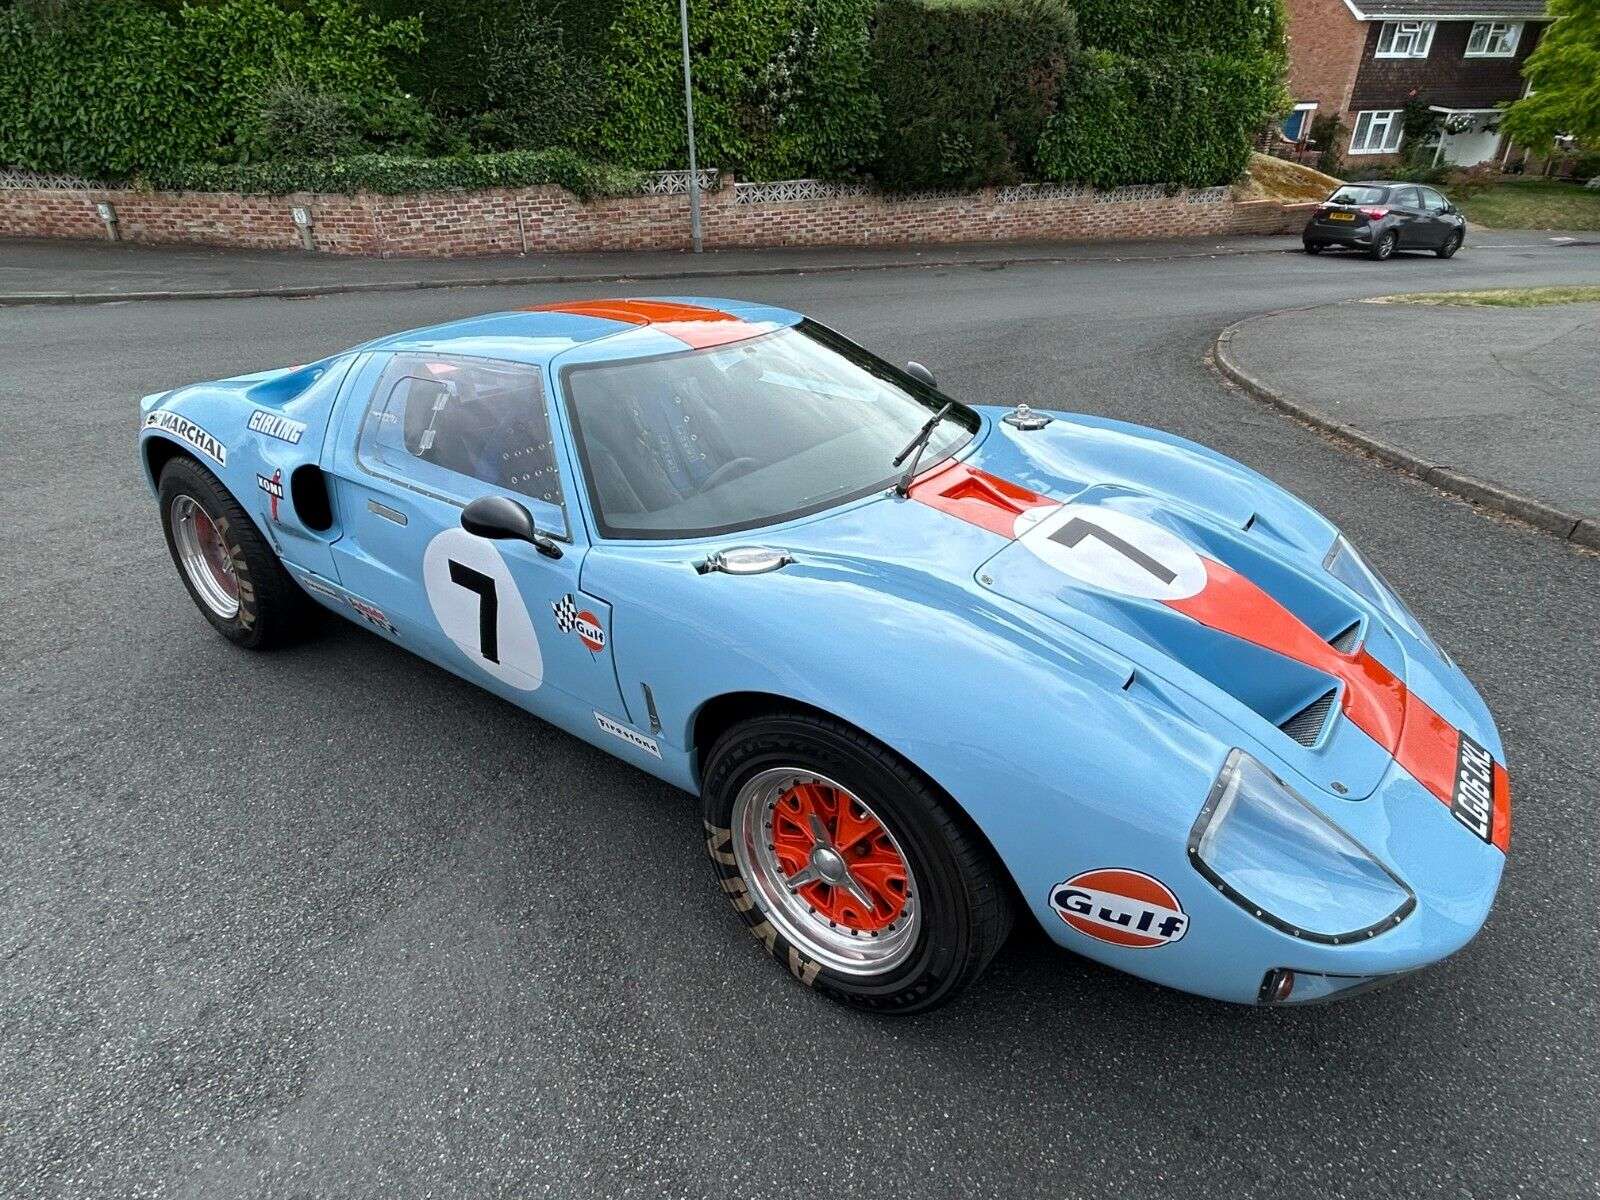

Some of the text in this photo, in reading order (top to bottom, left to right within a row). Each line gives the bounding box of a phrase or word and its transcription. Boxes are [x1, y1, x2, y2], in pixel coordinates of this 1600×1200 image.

[159, 413, 224, 463] MARCHAL
[250, 410, 304, 443] GIRLING
[257, 476, 283, 497] KONI
[1046, 516, 1178, 585] 7
[447, 558, 500, 665] 7
[576, 621, 604, 643] Gulf
[598, 718, 657, 752] Firestone
[1455, 741, 1490, 838] LG06 CKL
[1054, 889, 1184, 937] Gulf
